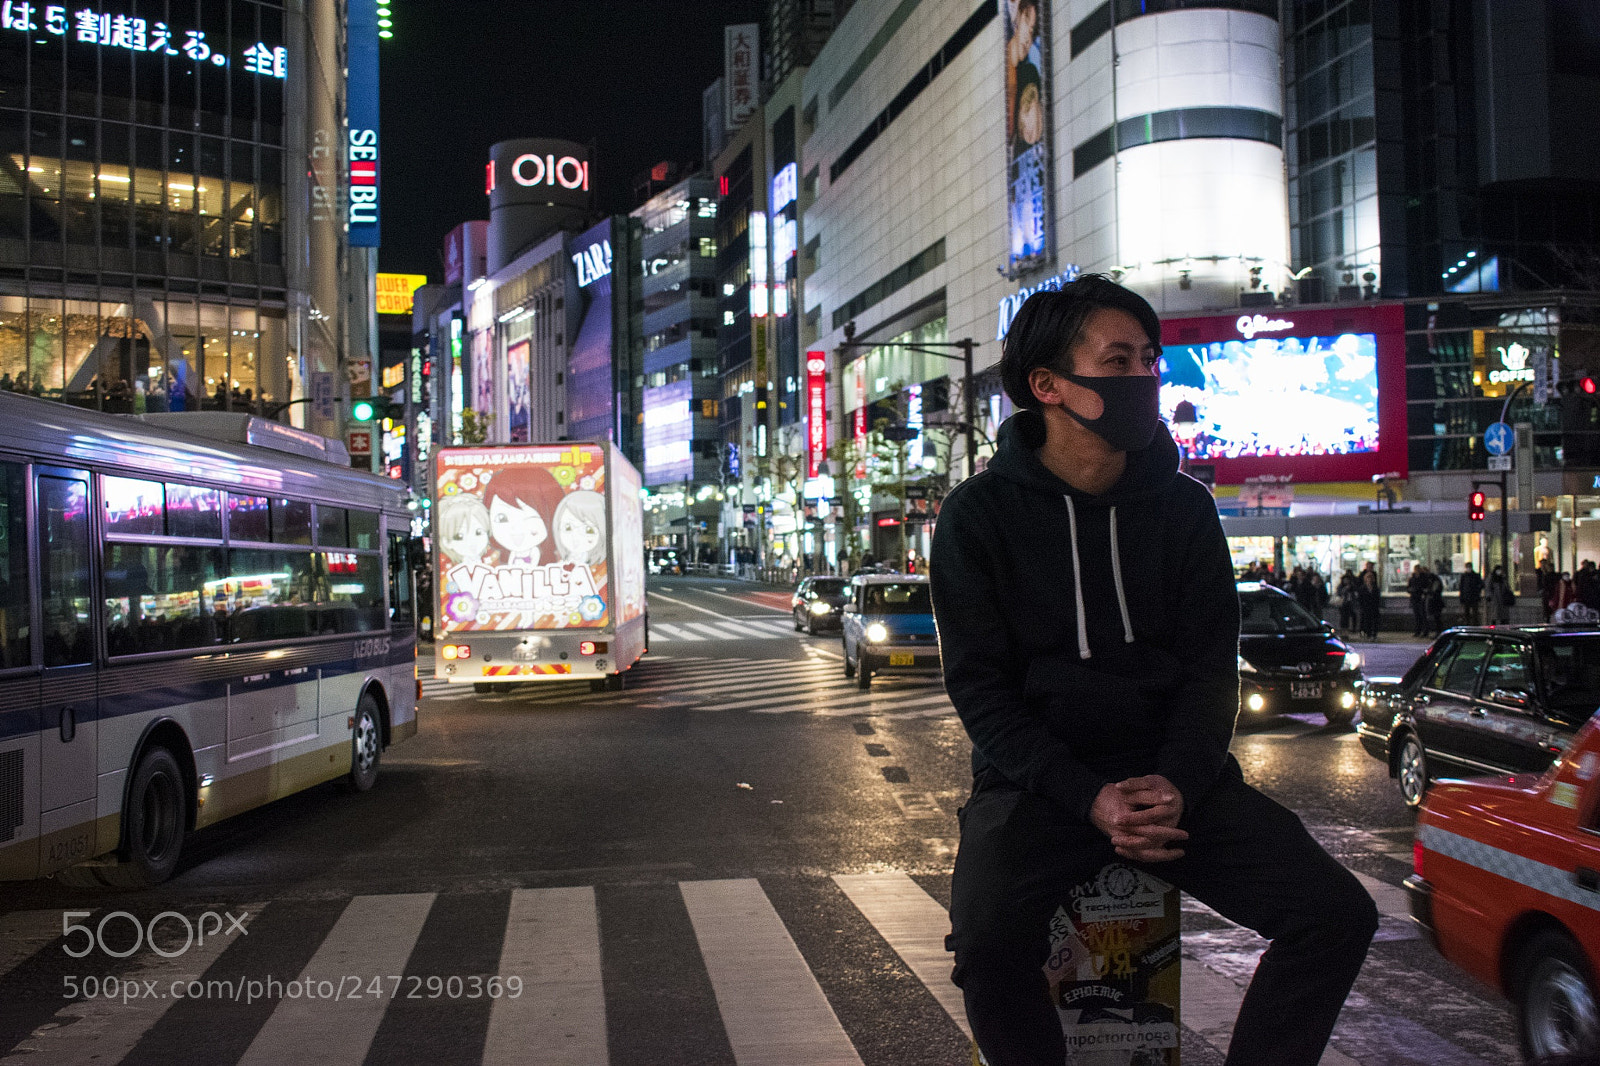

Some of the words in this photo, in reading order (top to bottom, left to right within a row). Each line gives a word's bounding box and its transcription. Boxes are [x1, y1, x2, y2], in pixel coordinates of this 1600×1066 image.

[349, 128, 378, 224] SEIBU
[571, 239, 613, 288] ZARA
[449, 564, 599, 601] VANILLA
